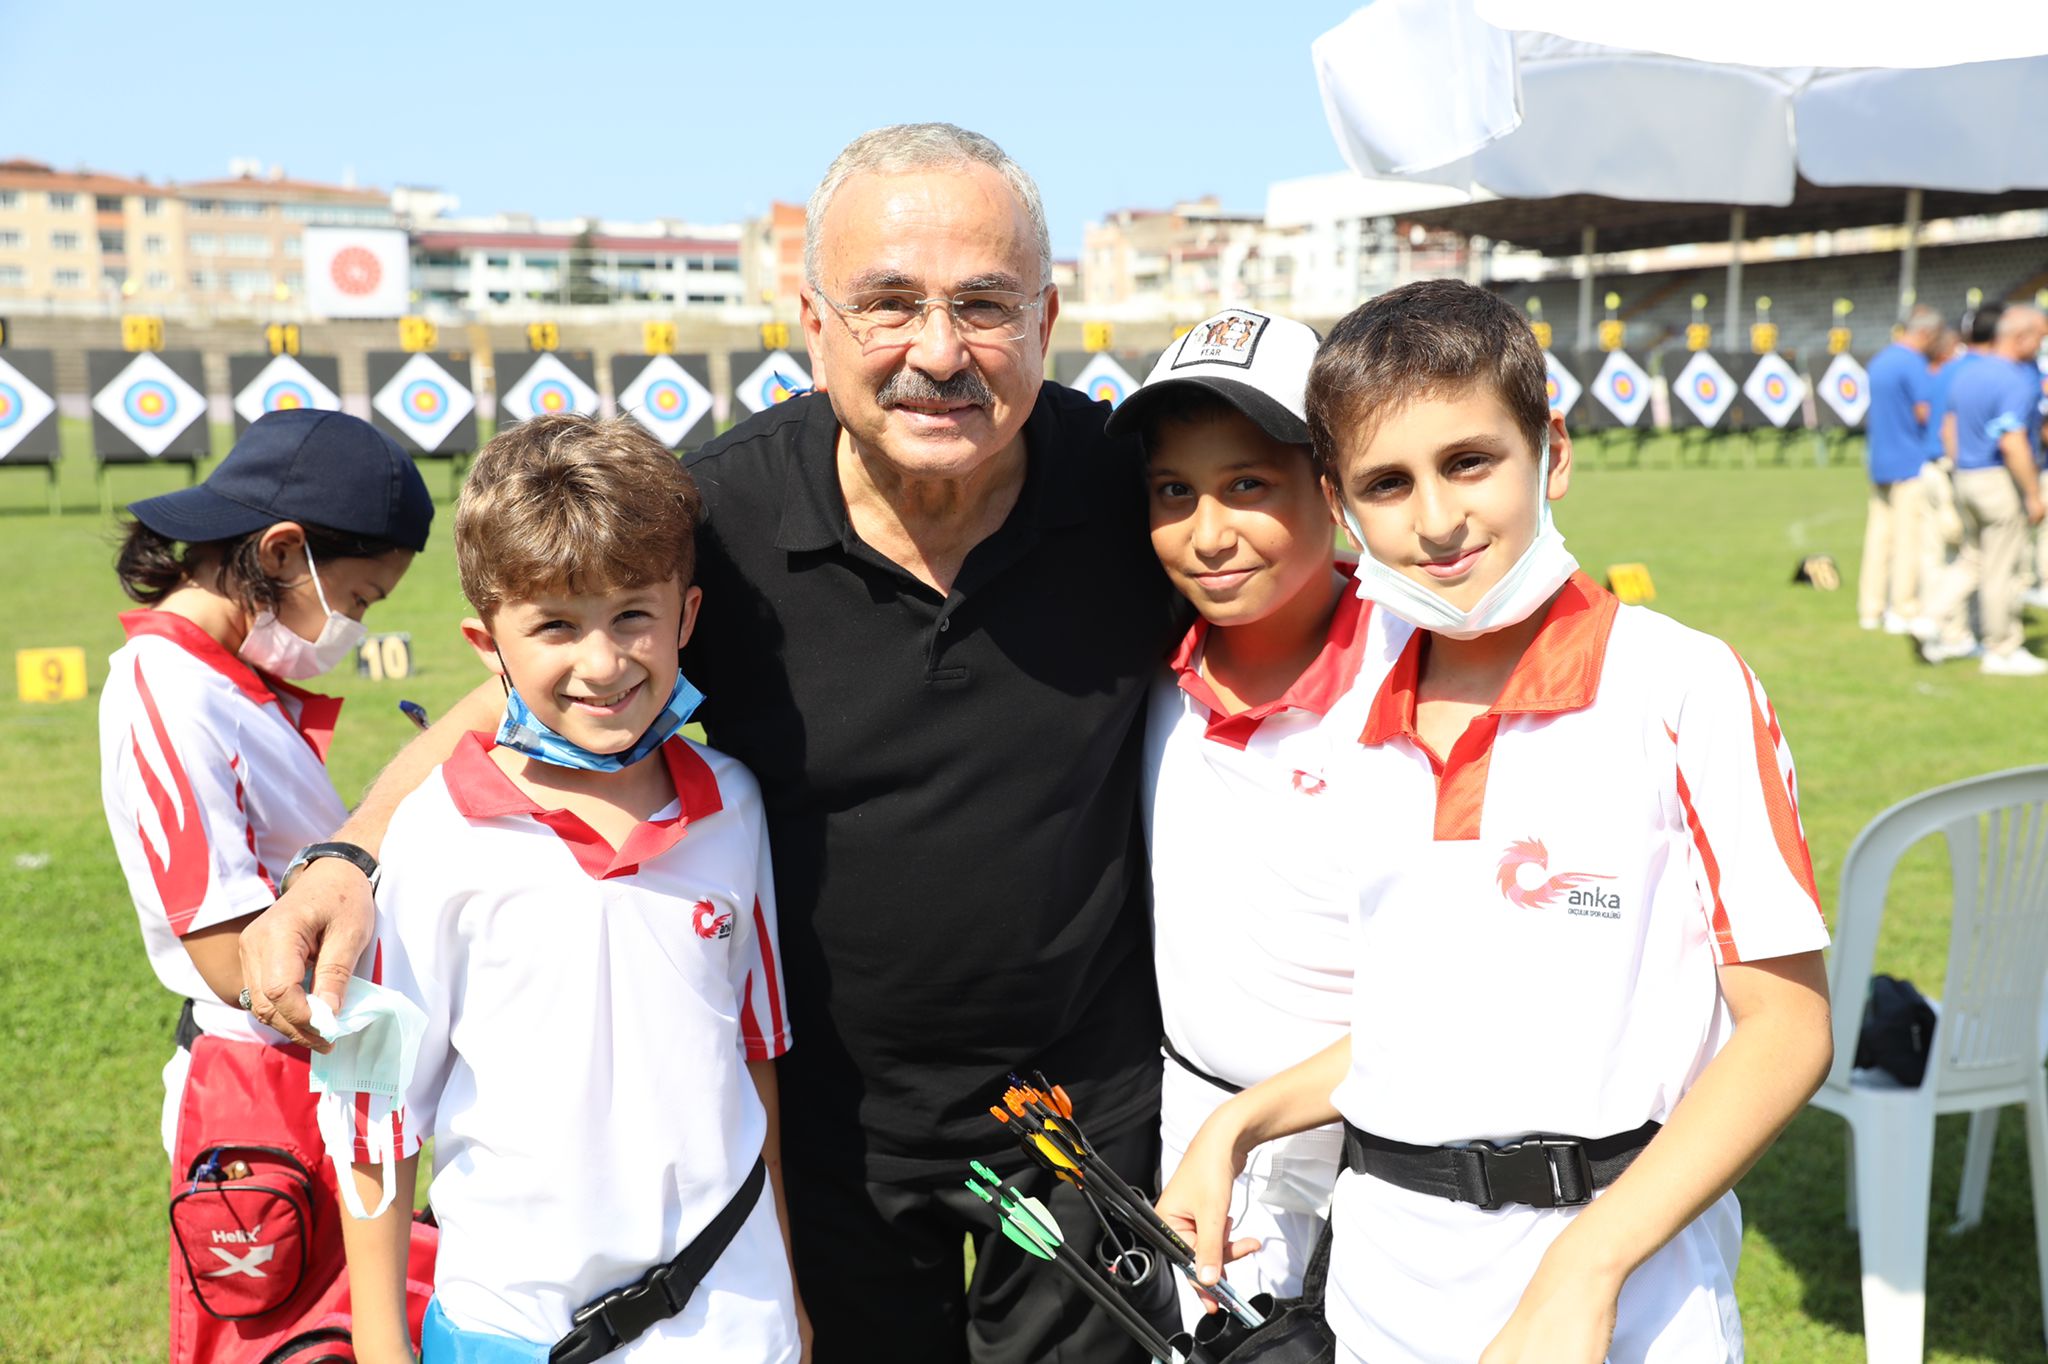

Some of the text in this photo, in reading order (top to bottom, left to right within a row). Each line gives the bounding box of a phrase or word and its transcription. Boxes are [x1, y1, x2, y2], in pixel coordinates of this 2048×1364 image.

[360, 636, 408, 681] 10
[41, 657, 65, 699] 9
[1568, 886, 1620, 909] anka
[211, 1224, 261, 1244] Helix
